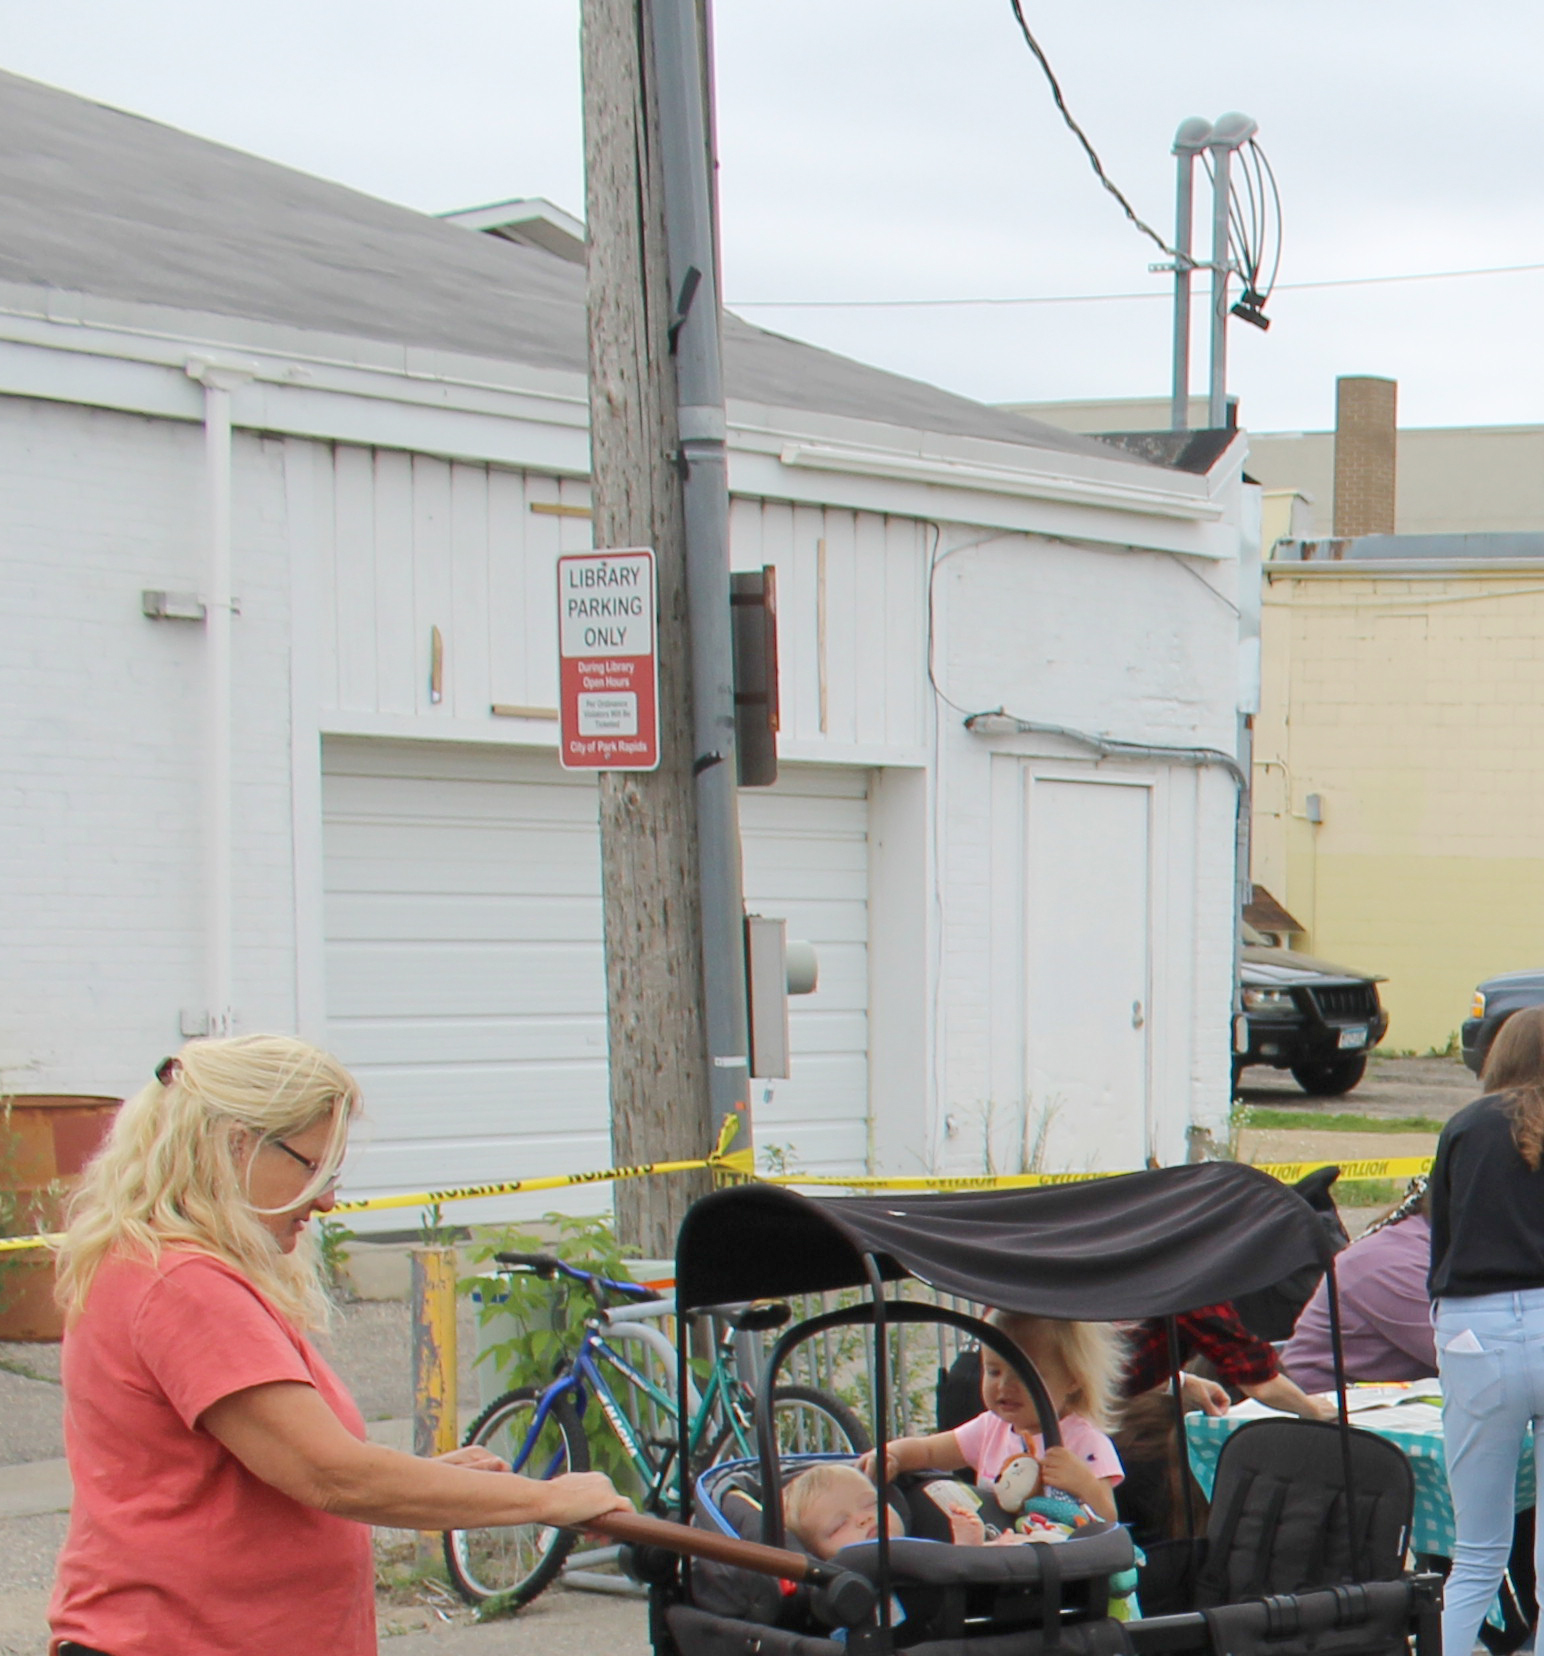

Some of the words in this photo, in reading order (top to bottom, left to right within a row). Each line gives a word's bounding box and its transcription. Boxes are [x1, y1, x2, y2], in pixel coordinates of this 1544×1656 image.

[569, 566, 641, 588] LIBRARY
[568, 596, 643, 618] PARKING
[584, 626, 627, 648] ONLY
[578, 661, 605, 675] During
[605, 660, 635, 675] Library
[583, 676, 605, 690] Open
[605, 676, 630, 688] Hours
[570, 741, 587, 756] City
[587, 740, 596, 752] of
[597, 740, 617, 753] Park
[618, 739, 648, 753] Rapids
